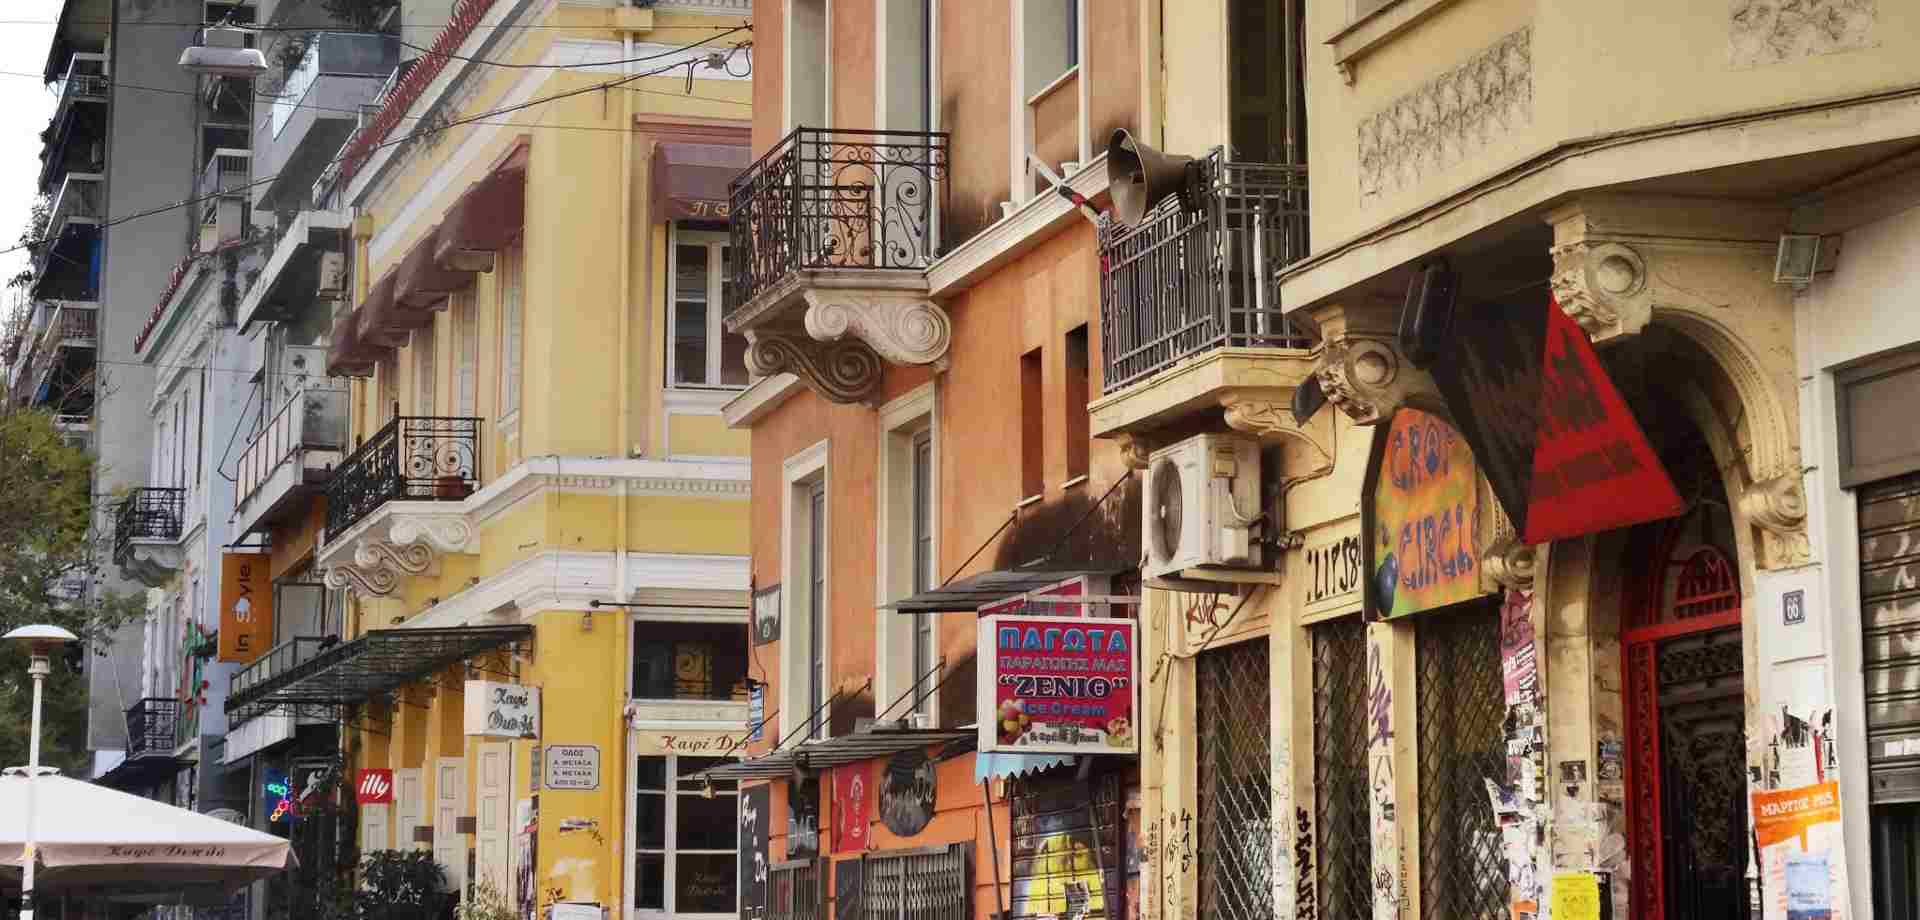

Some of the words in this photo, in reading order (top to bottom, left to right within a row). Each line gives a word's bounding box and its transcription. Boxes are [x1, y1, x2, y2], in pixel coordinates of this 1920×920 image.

[1786, 597, 1799, 619] 66
[1000, 627, 1128, 652] ΠΑΓΩΤΑ
[1051, 703, 1105, 716] Cream
[360, 774, 389, 800] illy
